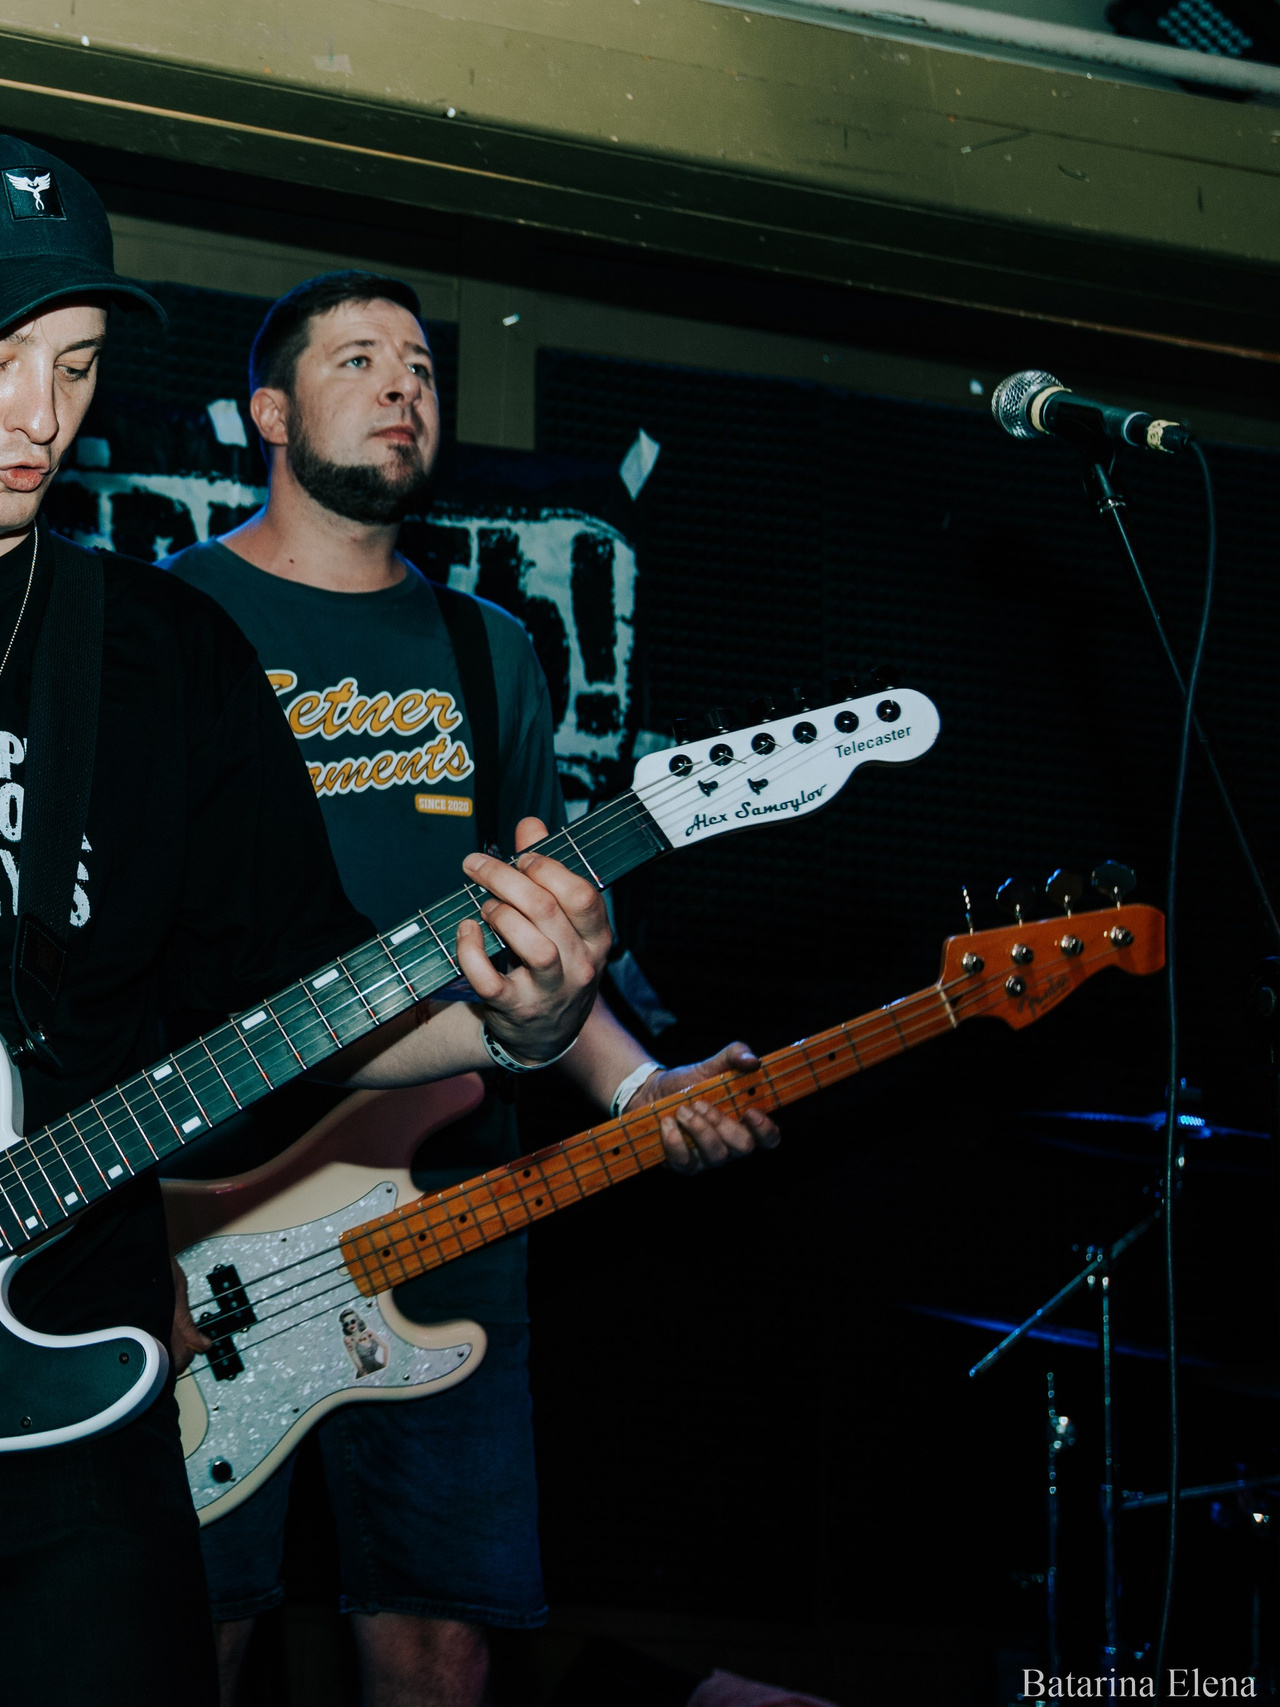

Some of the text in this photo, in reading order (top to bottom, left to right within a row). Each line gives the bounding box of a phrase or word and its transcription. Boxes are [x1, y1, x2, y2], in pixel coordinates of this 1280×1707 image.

[834, 725, 913, 759] Telecaster
[418, 797, 469, 813] SINCE 2020
[685, 783, 827, 837] Alex Samoylov
